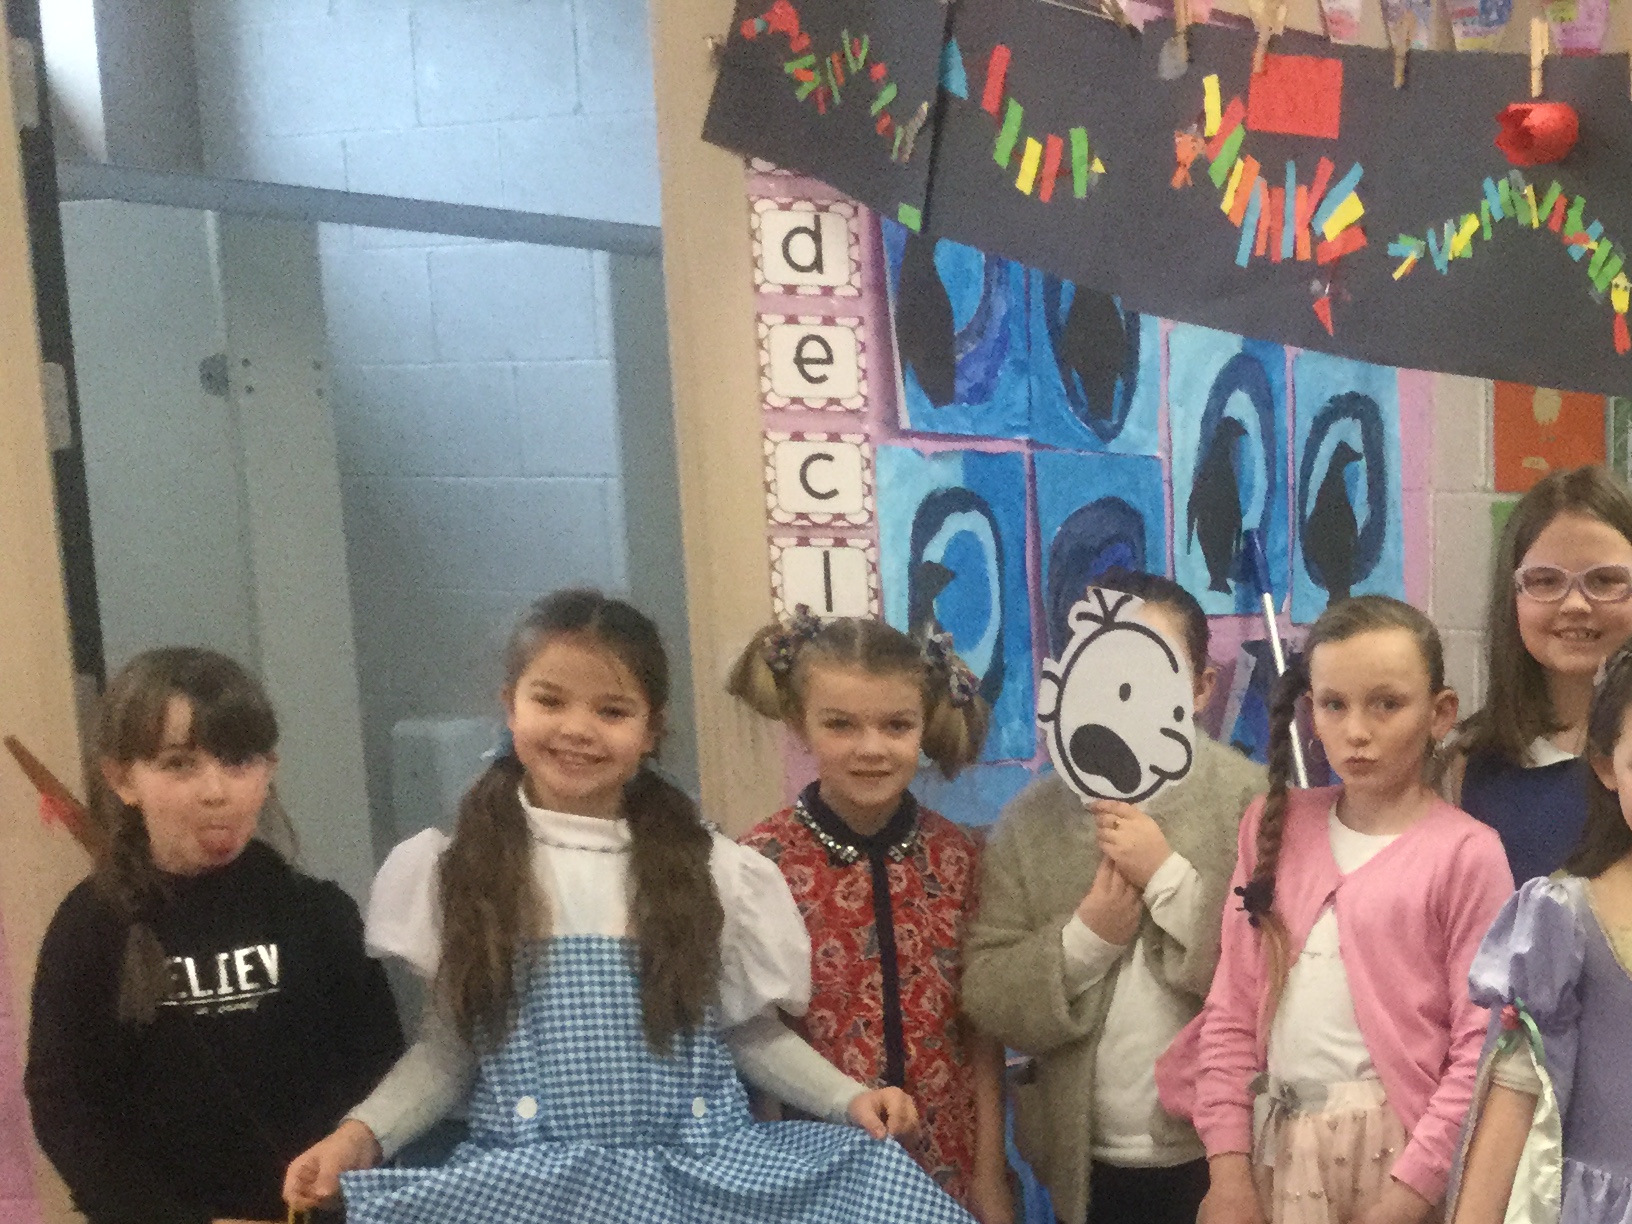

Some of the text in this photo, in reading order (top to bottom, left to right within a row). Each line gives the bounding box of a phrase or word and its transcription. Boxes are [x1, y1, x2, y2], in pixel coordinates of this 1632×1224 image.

[781, 214, 824, 275] d
[792, 334, 834, 384] e
[800, 453, 839, 500] c
